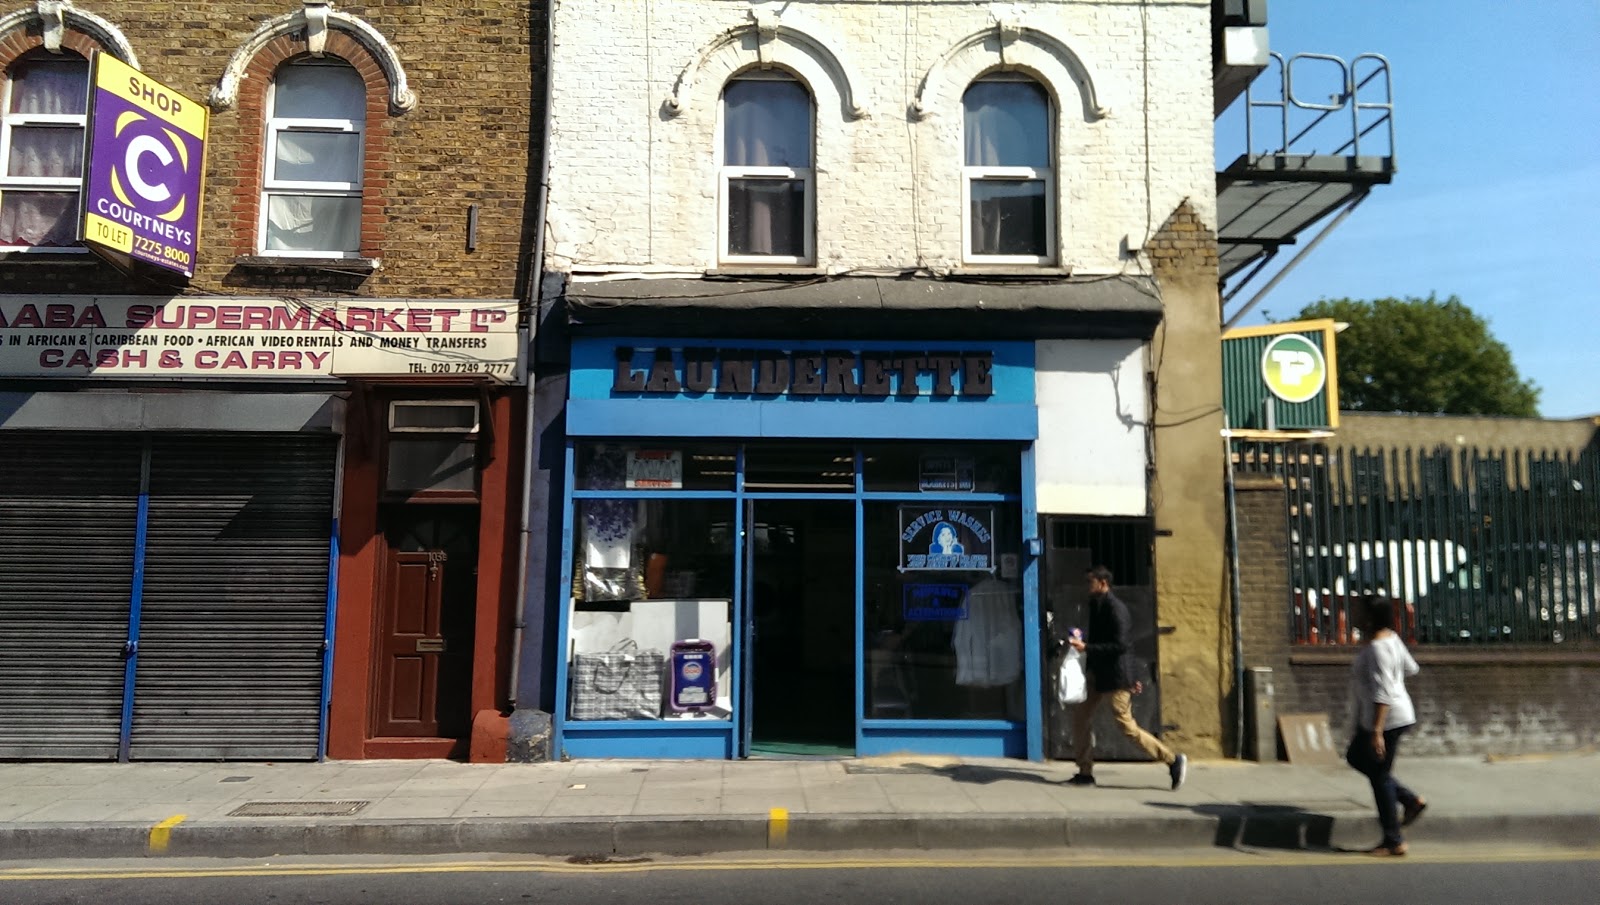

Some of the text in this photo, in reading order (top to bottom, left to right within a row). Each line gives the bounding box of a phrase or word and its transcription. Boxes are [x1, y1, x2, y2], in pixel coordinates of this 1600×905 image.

[129, 76, 182, 116] SHOP
[97, 198, 192, 245] COURTNEYS
[97, 221, 127, 246] TO LET
[134, 235, 190, 266] 7275 8000
[0, 304, 106, 329] ABA
[126, 304, 461, 333] SUPERMARKET
[9, 335, 21, 346] IN
[27, 334, 76, 346] AFRICAN
[79, 334, 87, 346] &
[94, 334, 158, 347] CARIBBEAN
[164, 335, 194, 347] FOOD
[206, 335, 254, 347] AFRICAN
[261, 336, 293, 348] VIDEO
[296, 336, 343, 348] RENTALS
[350, 337, 373, 348] AND
[380, 337, 420, 349] MONEY
[426, 338, 487, 349] TRANSFERS
[39, 349, 331, 370] CASH & CARRY
[408, 362, 509, 374] TEL: 020 7249 2777
[613, 346, 994, 396] LAUNDERETTE
[902, 510, 991, 544] SERVICE WASHES
